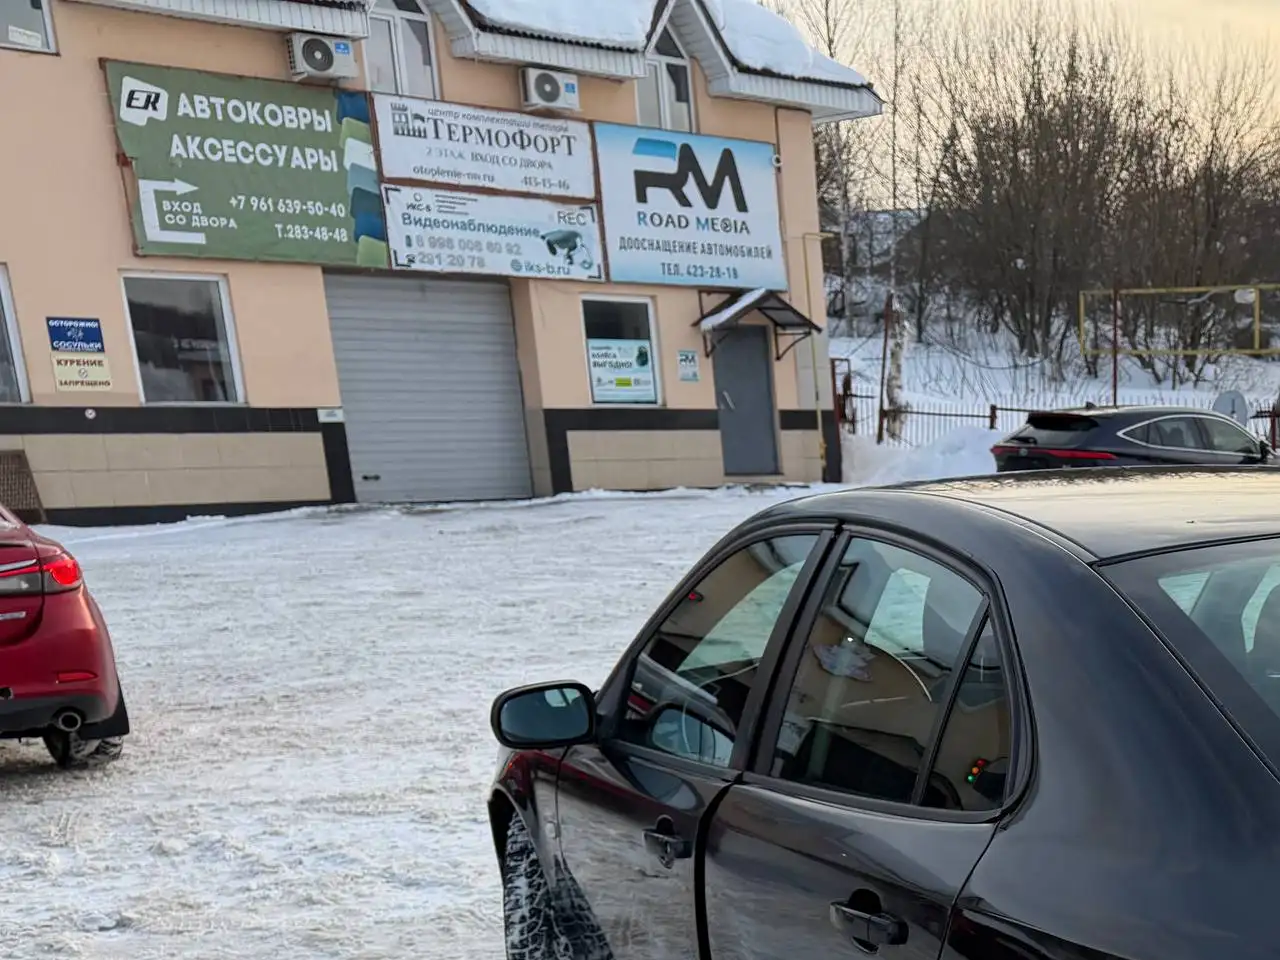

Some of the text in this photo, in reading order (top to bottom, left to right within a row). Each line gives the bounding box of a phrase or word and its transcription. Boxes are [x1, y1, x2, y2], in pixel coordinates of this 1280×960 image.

[177, 92, 332, 132] АВТОКОВРЫ
[427, 117, 577, 156] ТЕРМОФОРТ
[170, 134, 338, 172] АКСЕССУАРЫ
[470, 151, 500, 167] ВХОД
[501, 155, 518, 168] СО
[519, 158, 553, 171] ДВОРА
[162, 200, 202, 215] ВХОД
[229, 197, 345, 218] +7 961 639-50-40
[165, 214, 238, 229] СО ДВОРА
[401, 212, 540, 239] Видеонаблюдение
[557, 210, 587, 227] REC
[636, 211, 689, 229] ROAD
[619, 236, 773, 260] ДООСНАЩЕНИЕ АВТОМОБИЛЕЙ
[661, 262, 684, 278] ТЕЛ.
[53, 341, 102, 350] СОСУЛЬКИ
[56, 359, 105, 367] КУРЕНИЕ
[59, 379, 111, 388] ЗАПРЕЩЕНО
